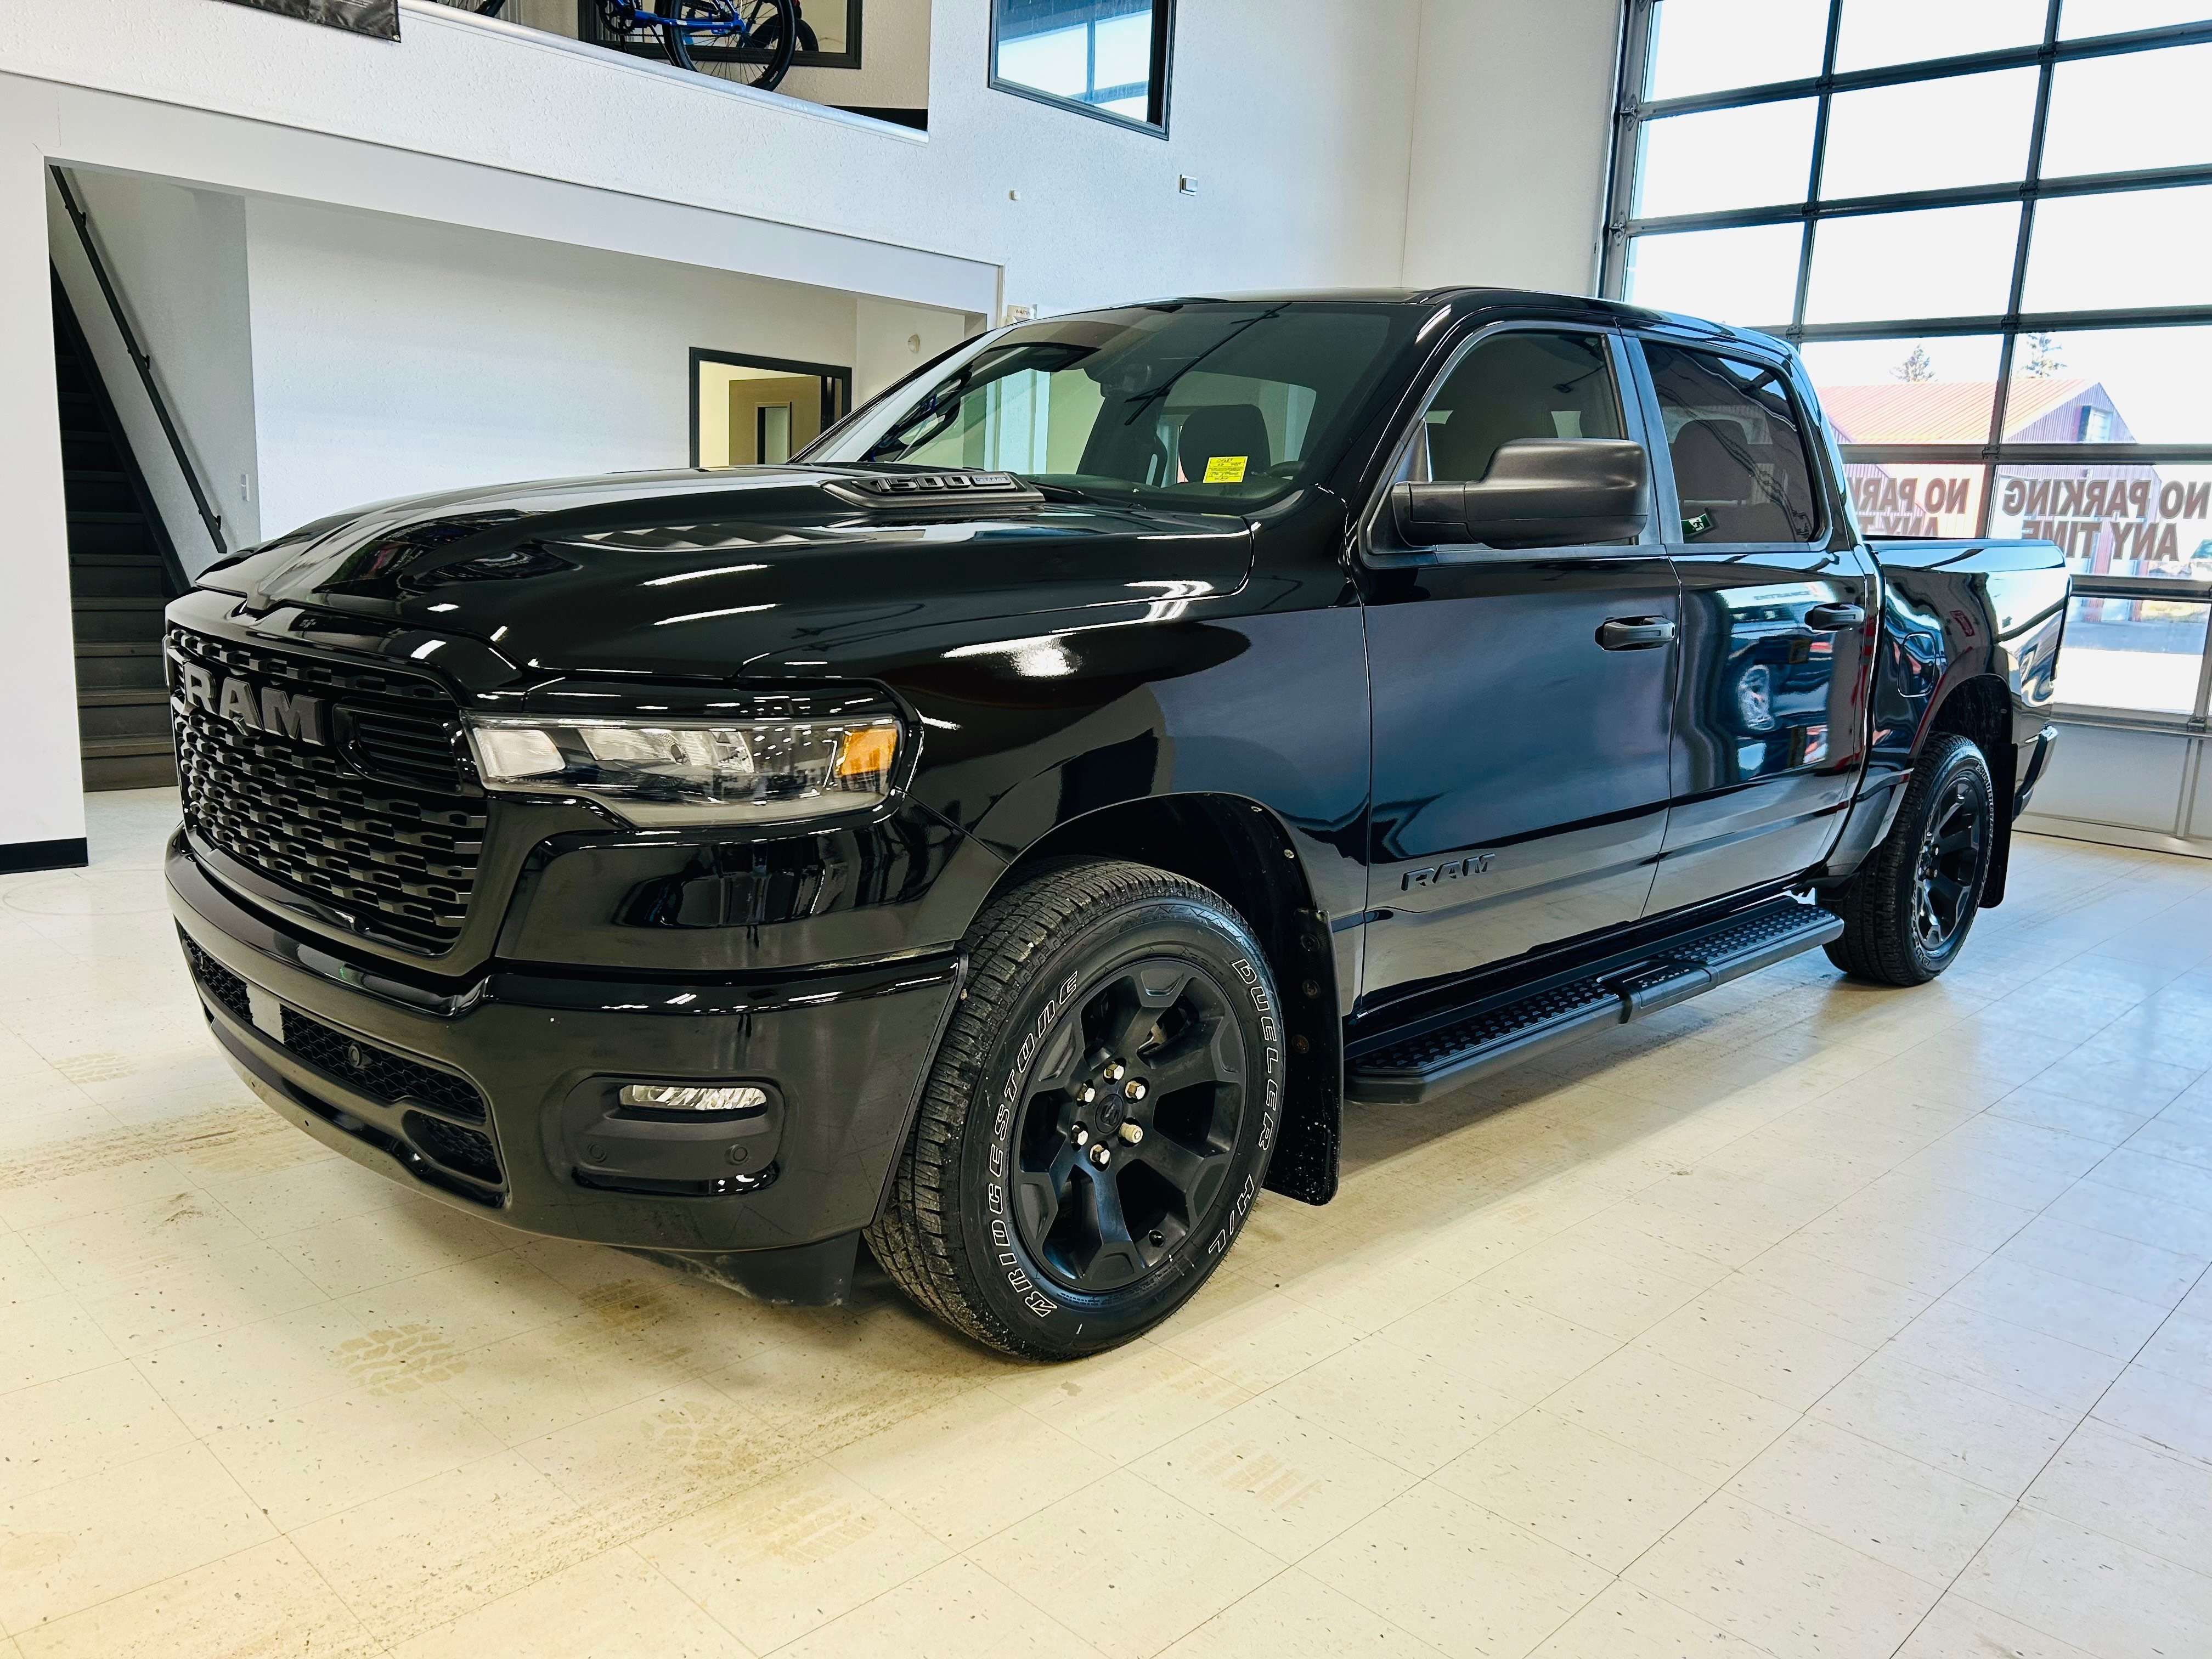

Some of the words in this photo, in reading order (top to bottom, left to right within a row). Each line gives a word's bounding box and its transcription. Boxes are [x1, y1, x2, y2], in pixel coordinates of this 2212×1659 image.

[871, 475, 971, 492] 1500
[183, 662, 325, 746] RAM
[1401, 853, 1495, 890] RAM
[1231, 958, 1279, 1151] DUELER
[988, 970, 1079, 1318] BRIDGESTONE
